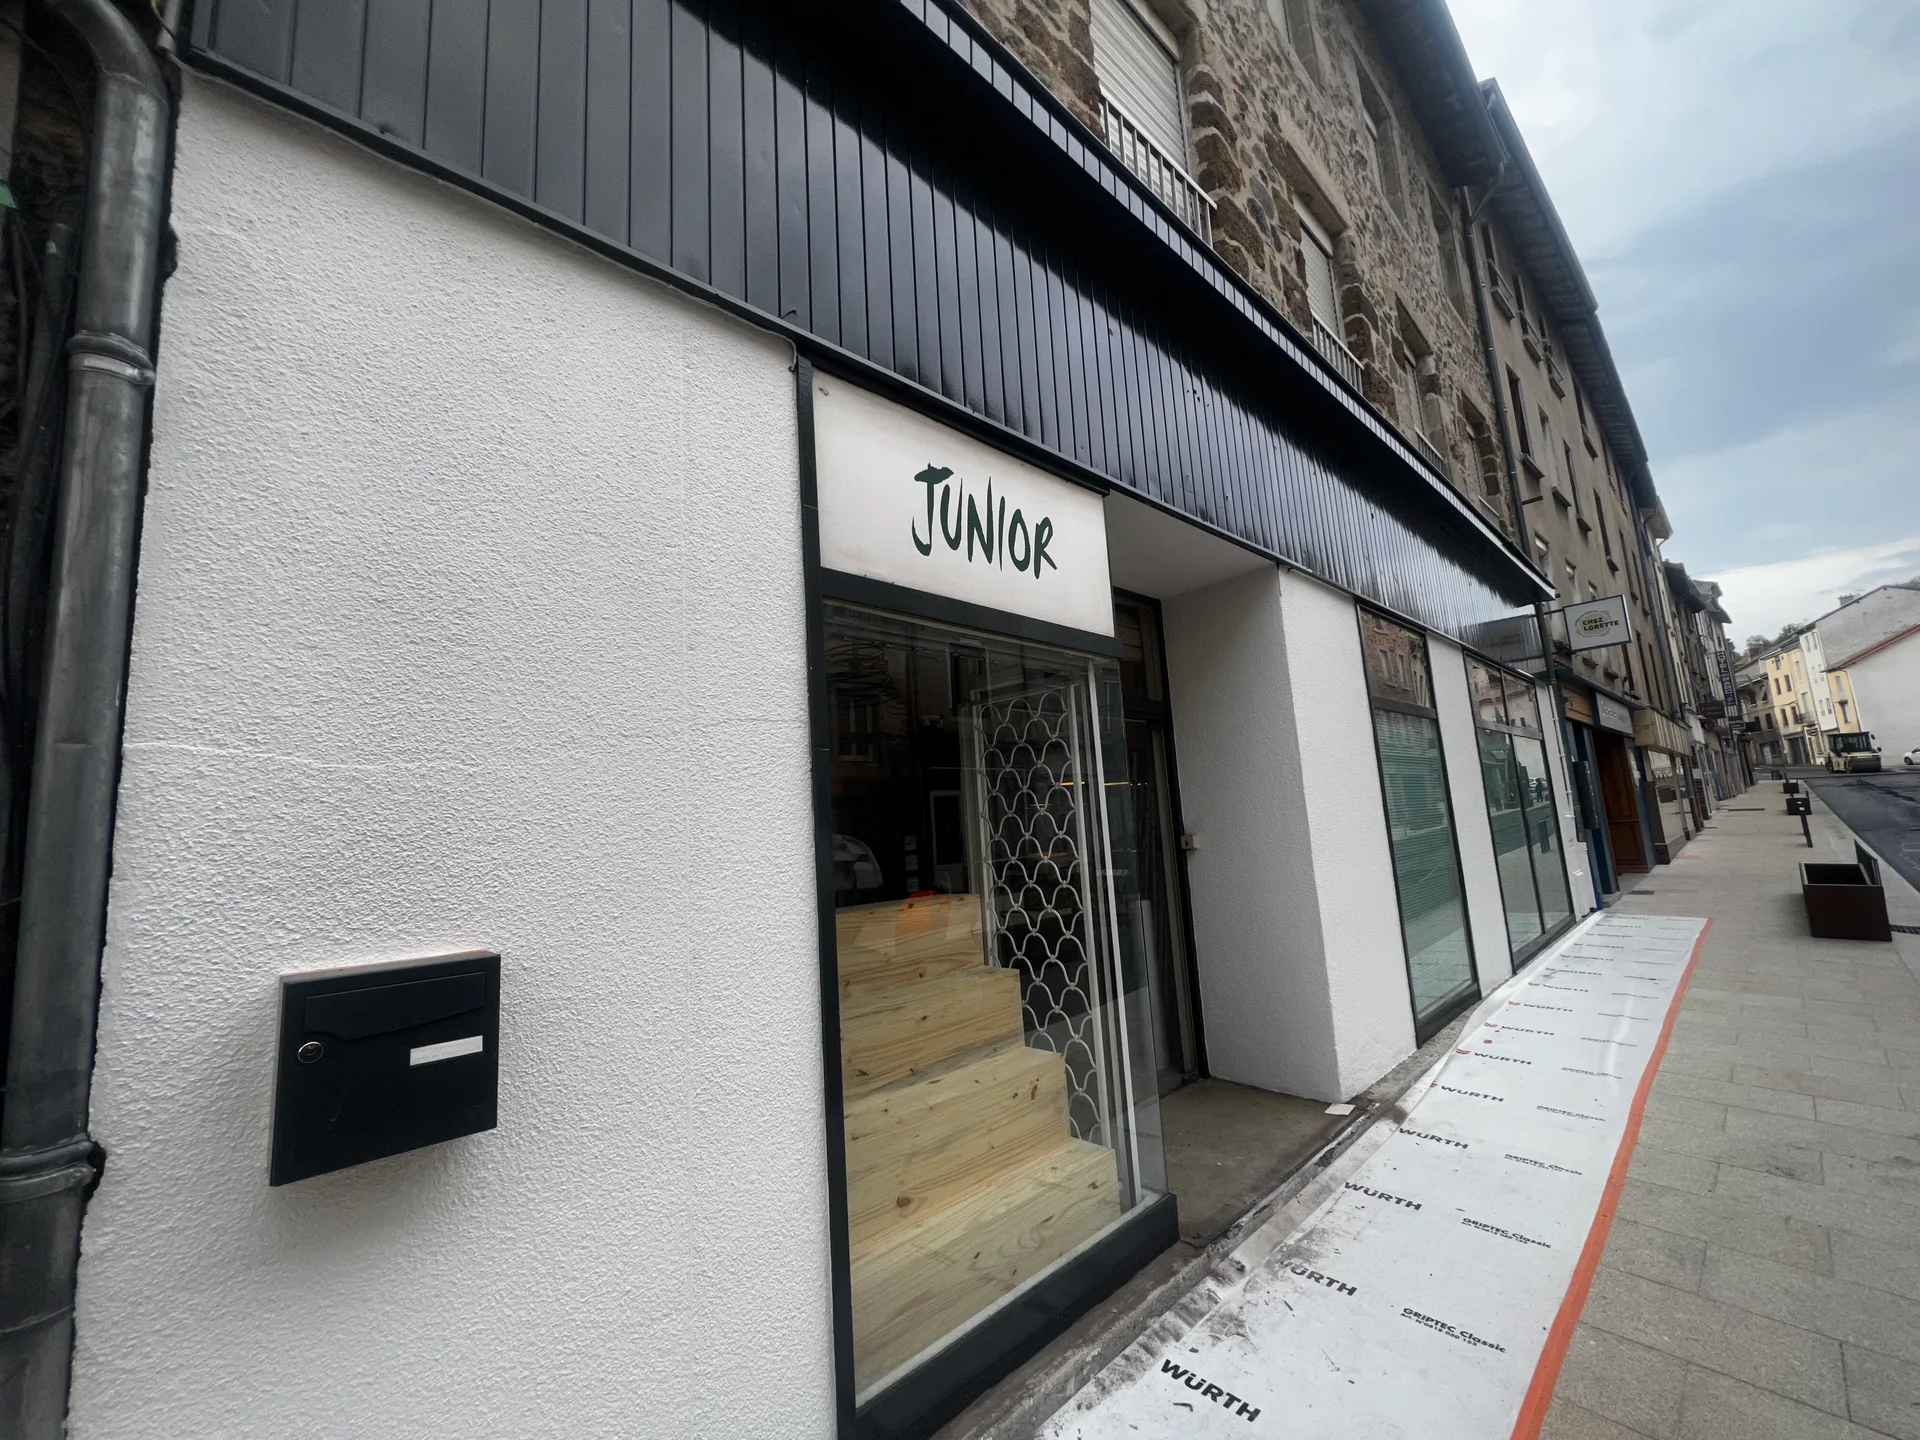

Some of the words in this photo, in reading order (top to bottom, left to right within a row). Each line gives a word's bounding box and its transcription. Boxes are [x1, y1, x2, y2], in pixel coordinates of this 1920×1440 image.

[912, 462, 1058, 579] JUNIOR
[1582, 617, 1604, 626] CHEZ
[1583, 620, 1619, 631] LORETTE
[1463, 1217, 1509, 1235] GRIPTEC
[1512, 1233, 1552, 1249] Classic
[1403, 1307, 1457, 1333] GRIPTEC
[1460, 1330, 1506, 1354] Classic
[1161, 1358, 1261, 1423] WÜRTH
